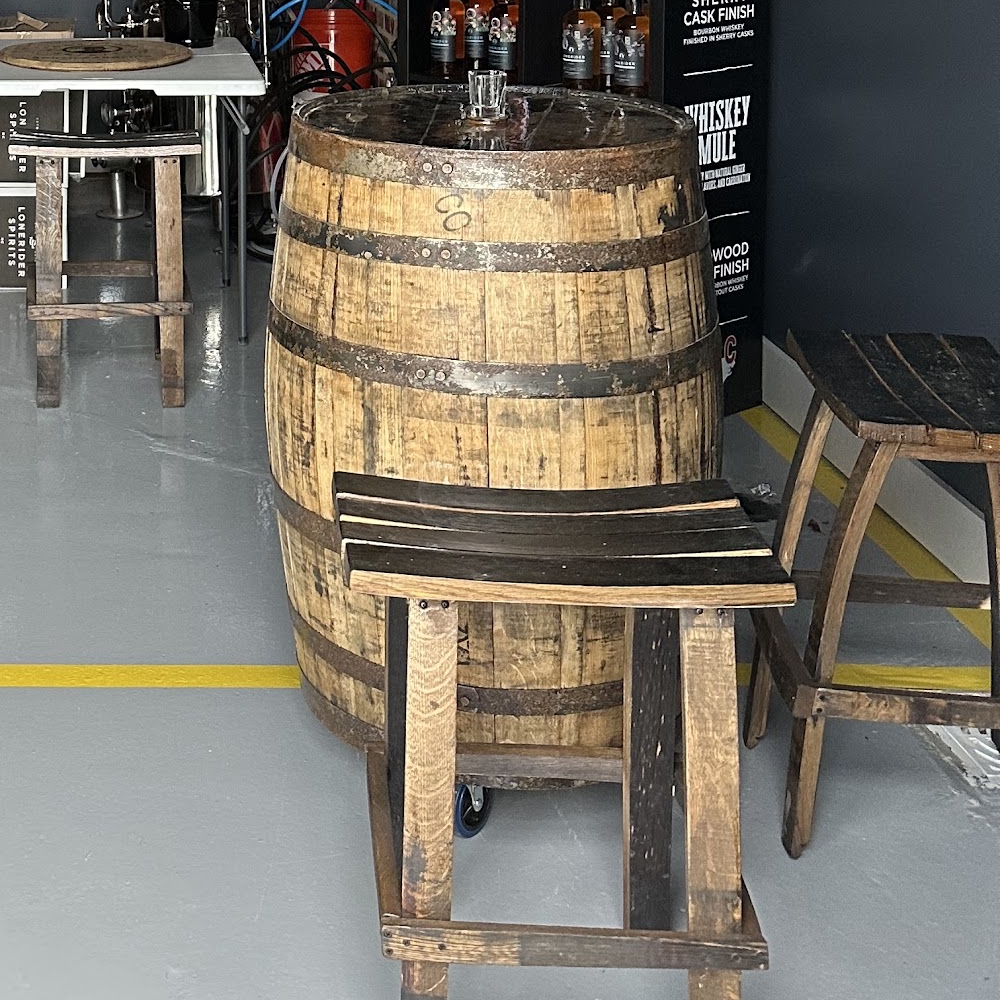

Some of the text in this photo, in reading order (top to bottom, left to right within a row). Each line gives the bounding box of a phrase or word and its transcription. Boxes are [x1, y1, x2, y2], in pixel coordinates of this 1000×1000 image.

[683, 4, 755, 26] CASK FINISH
[683, 36, 708, 45] FINISHED
[716, 32, 736, 41] SHERRY
[737, 29, 754, 38] CASKS
[693, 23, 745, 36] BOURBON WHISKEY
[698, 129, 737, 165] MULE
[8, 218, 16, 266] SPIRITS
[18, 207, 26, 277] LONERIDER
[711, 241, 749, 262] WOOD
[713, 258, 749, 279] FINISH
[715, 284, 744, 296] TOUT CASKS
[728, 275, 749, 285] WHISKEY
